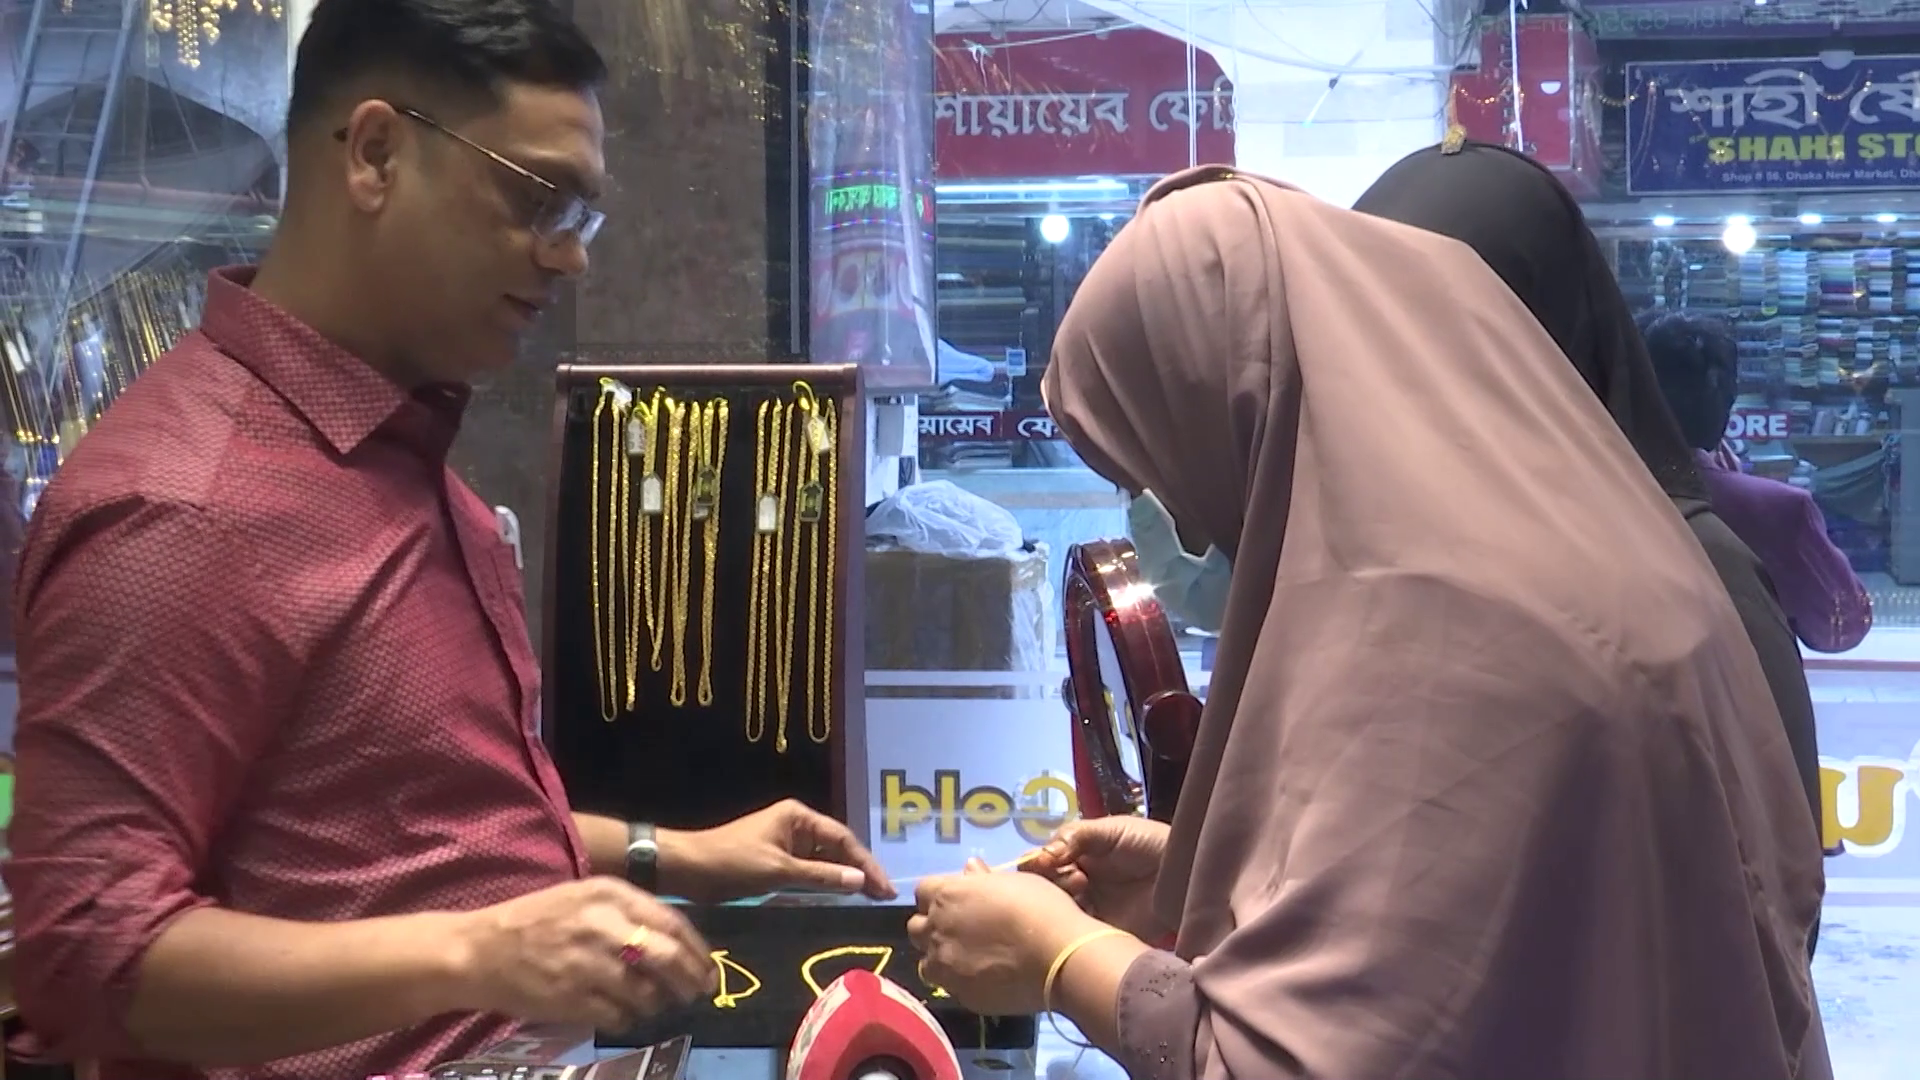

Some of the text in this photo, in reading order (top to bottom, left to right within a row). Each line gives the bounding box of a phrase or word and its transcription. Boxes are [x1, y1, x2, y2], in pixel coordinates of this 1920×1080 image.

[1707, 132, 1920, 163] SHAHI ST
[1721, 172, 1752, 184] Shop
[1785, 170, 1823, 181] Dhaka
[1825, 169, 1851, 180] New
[1724, 413, 1788, 438] ORE
